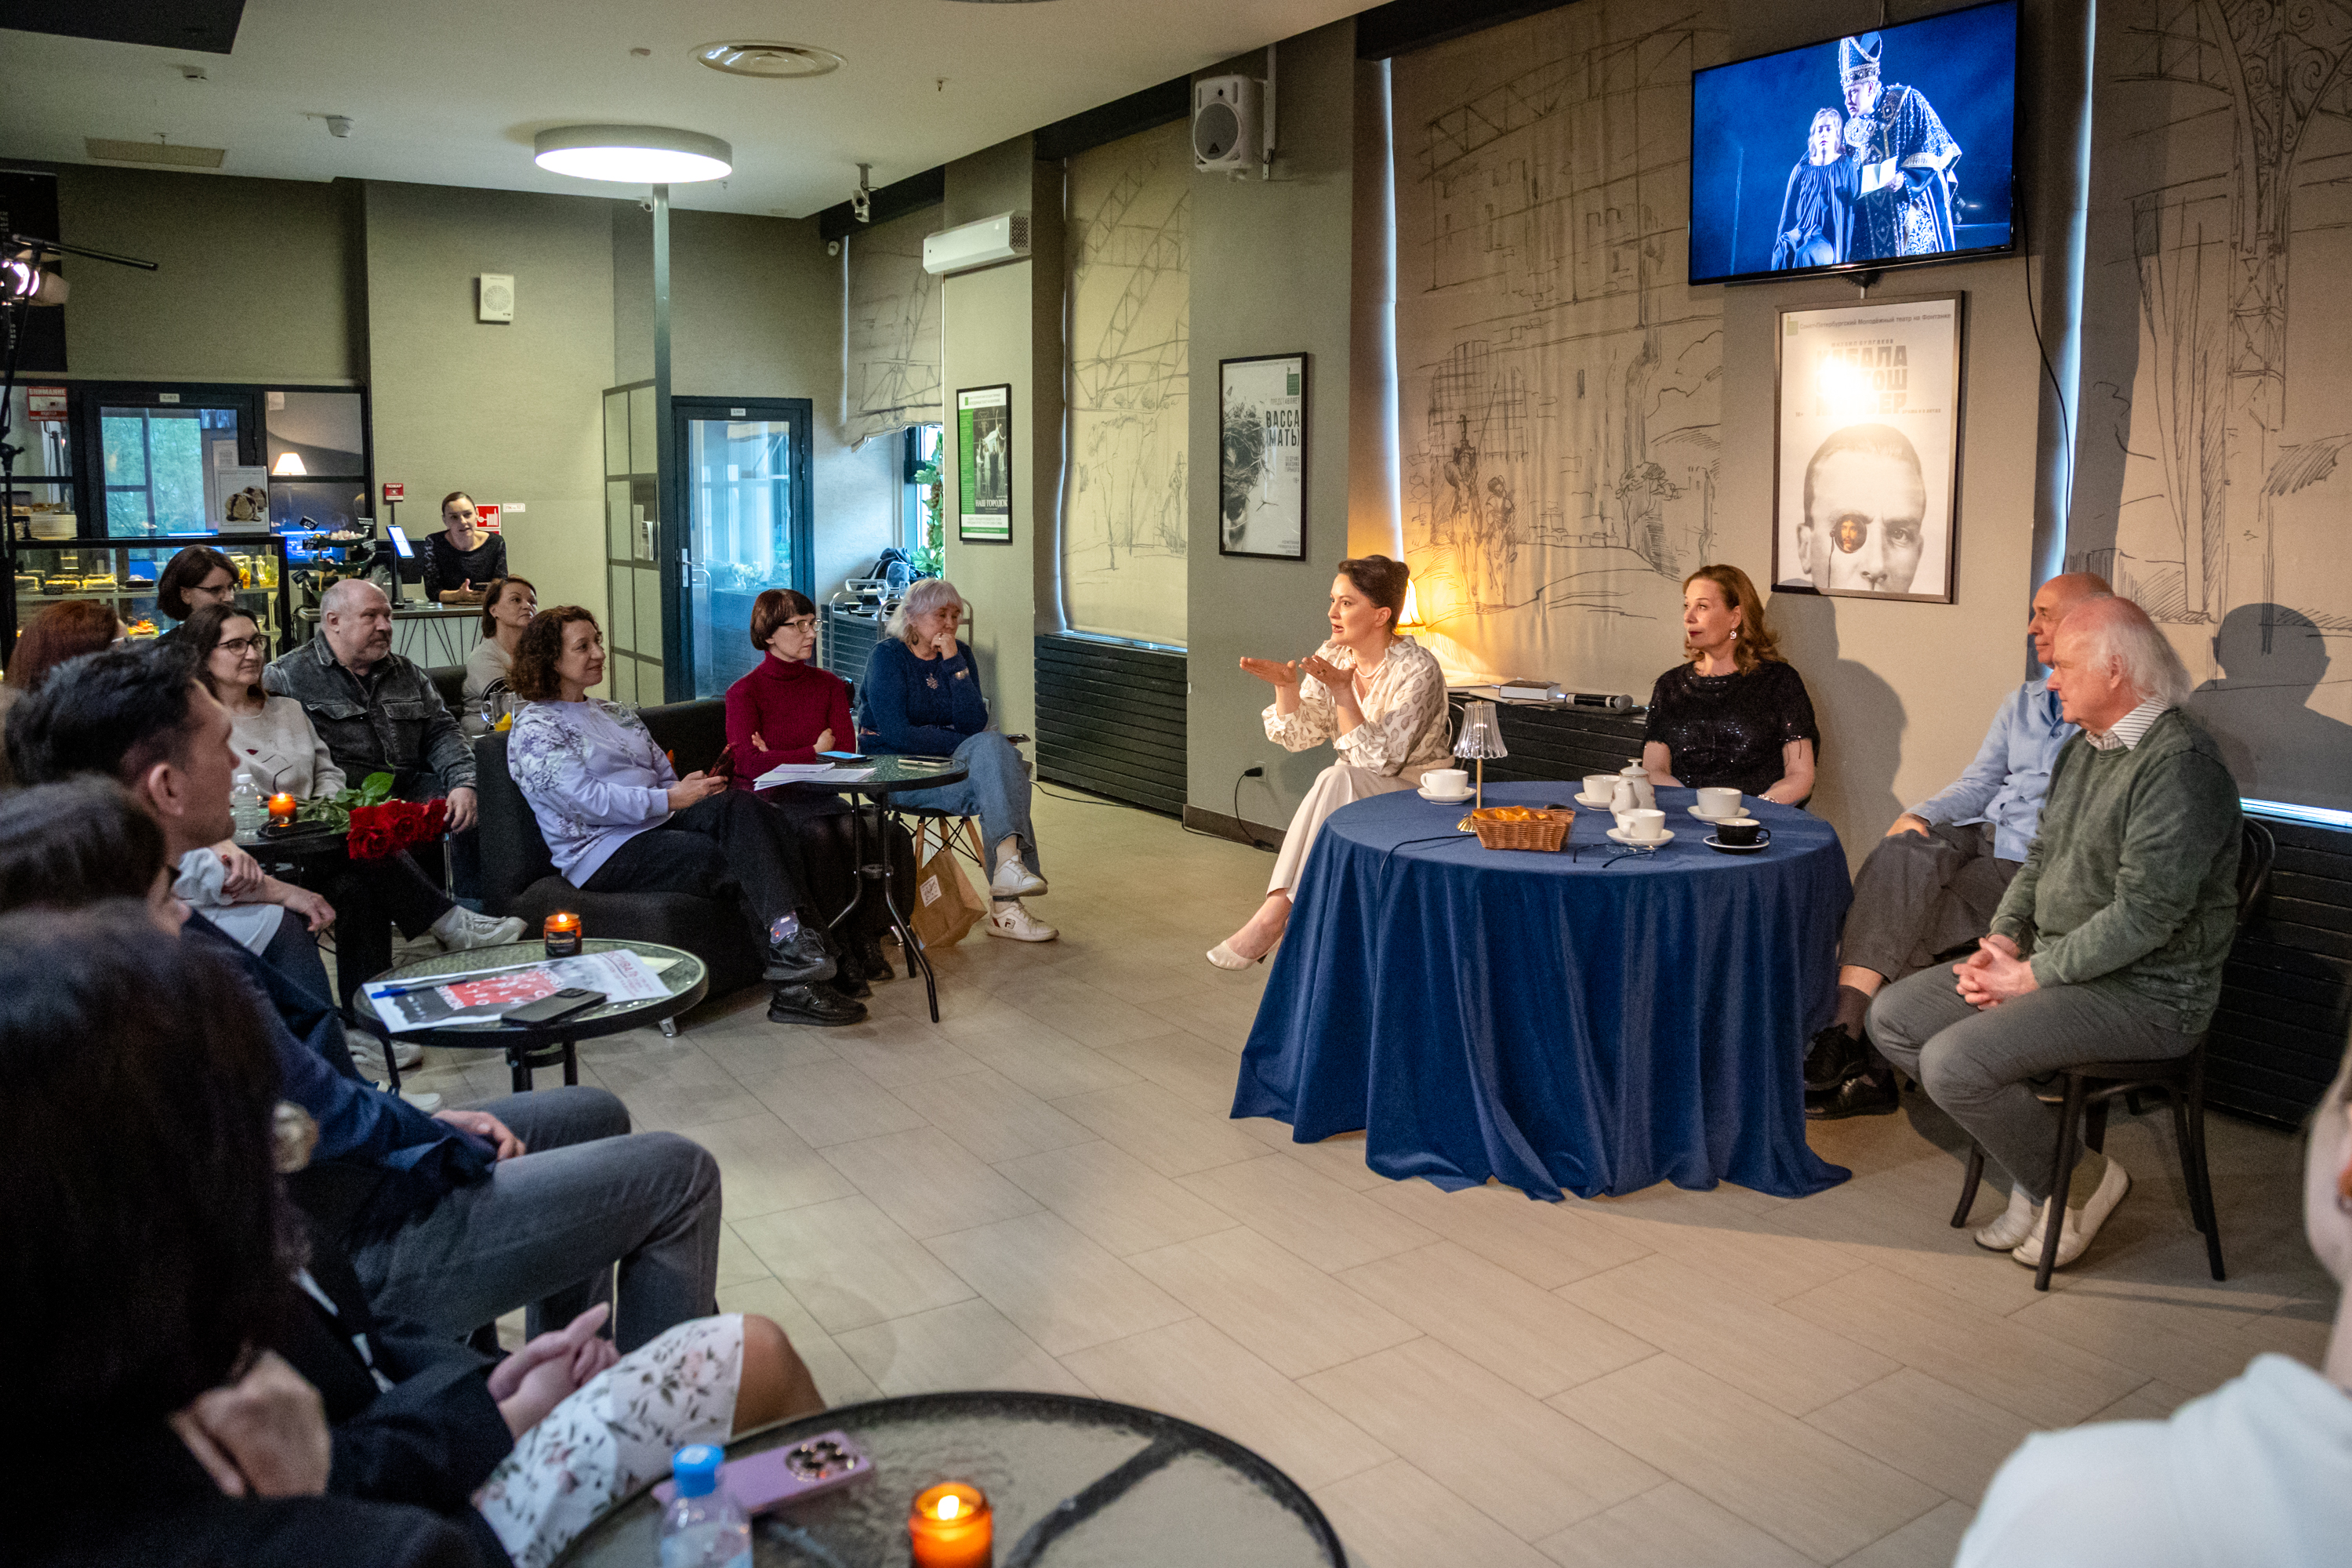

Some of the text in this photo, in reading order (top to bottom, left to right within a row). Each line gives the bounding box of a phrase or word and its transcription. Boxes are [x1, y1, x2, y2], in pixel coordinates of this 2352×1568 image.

[1266, 409, 1300, 428] ВАССА
[1266, 428, 1300, 447] (МАТЬ)
[986, 499, 1008, 508] ГОРОДОК
